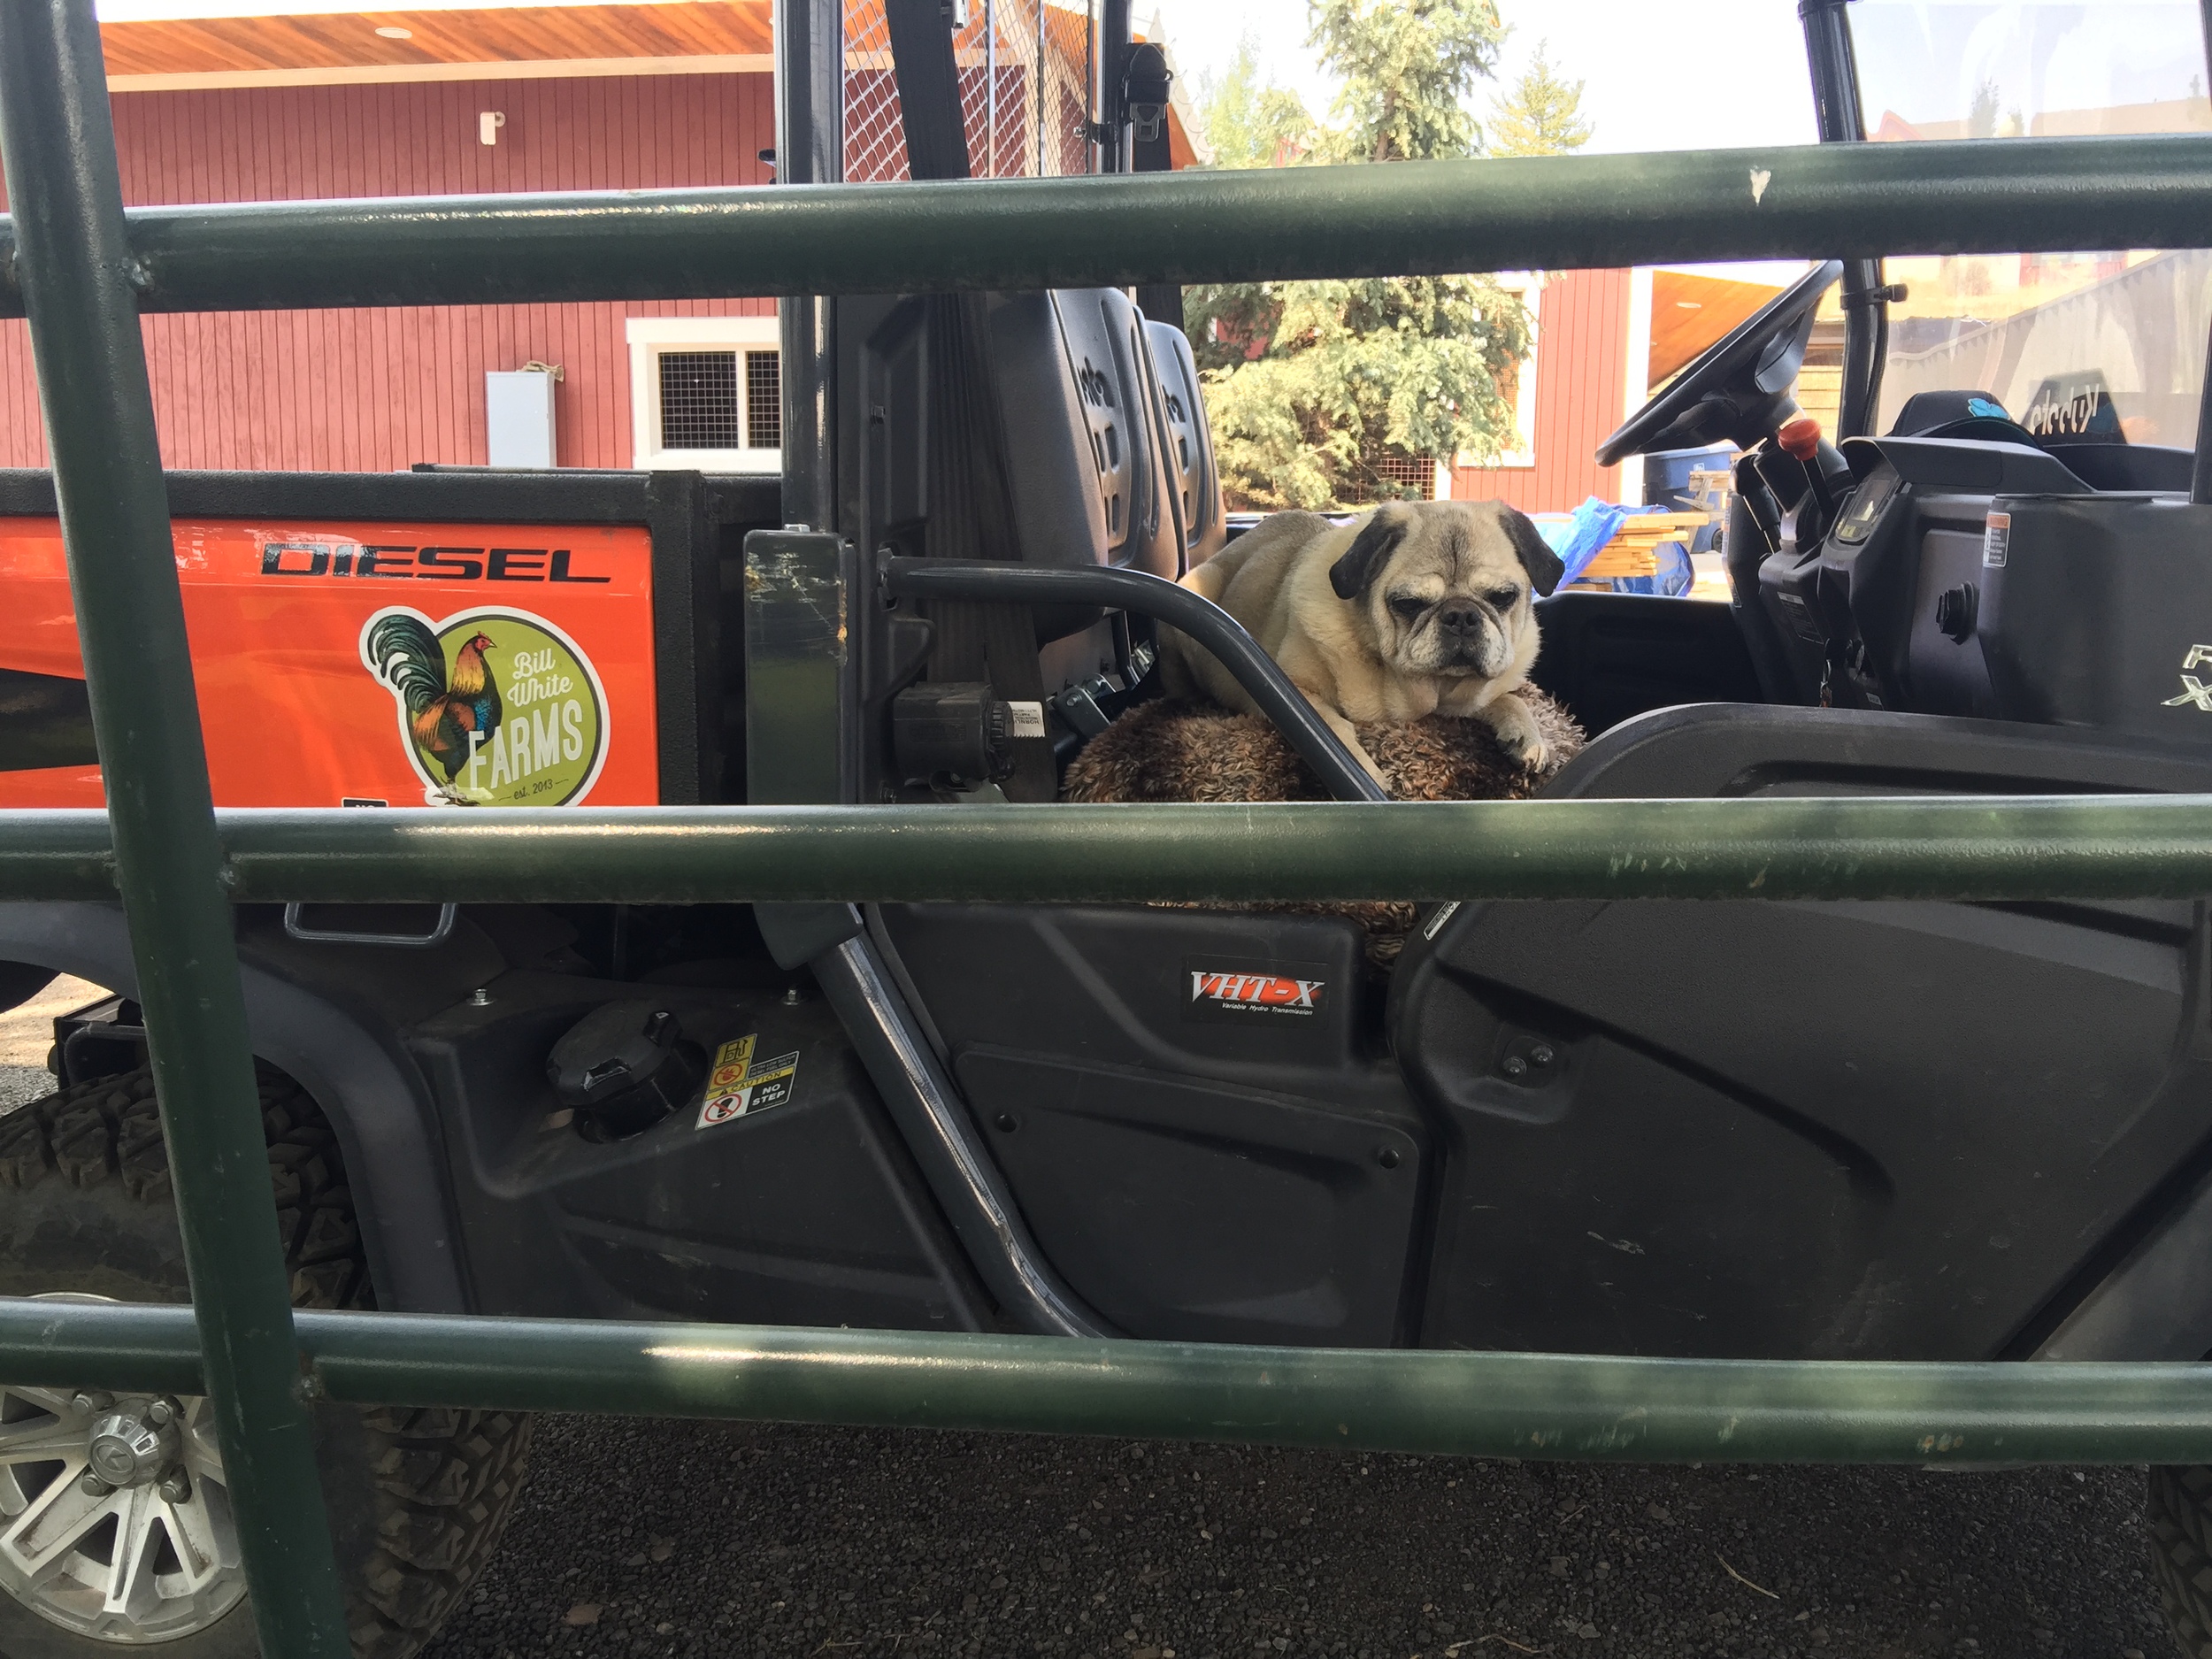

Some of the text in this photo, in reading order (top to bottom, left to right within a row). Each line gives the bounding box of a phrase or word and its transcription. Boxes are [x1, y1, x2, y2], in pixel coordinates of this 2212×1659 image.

[262, 542, 611, 583] DIESEL
[512, 648, 556, 680] Bill
[507, 674, 573, 707] White
[468, 699, 583, 791] FARMS
[513, 779, 554, 799] est. 2013
[1191, 971, 1325, 1008] VHT-X
[1222, 1002, 1247, 1010] Variable
[1271, 1006, 1313, 1016] Transmission
[732, 1071, 781, 1091] CAUTION
[762, 1083, 781, 1094] NO
[752, 1090, 786, 1106] STEP
